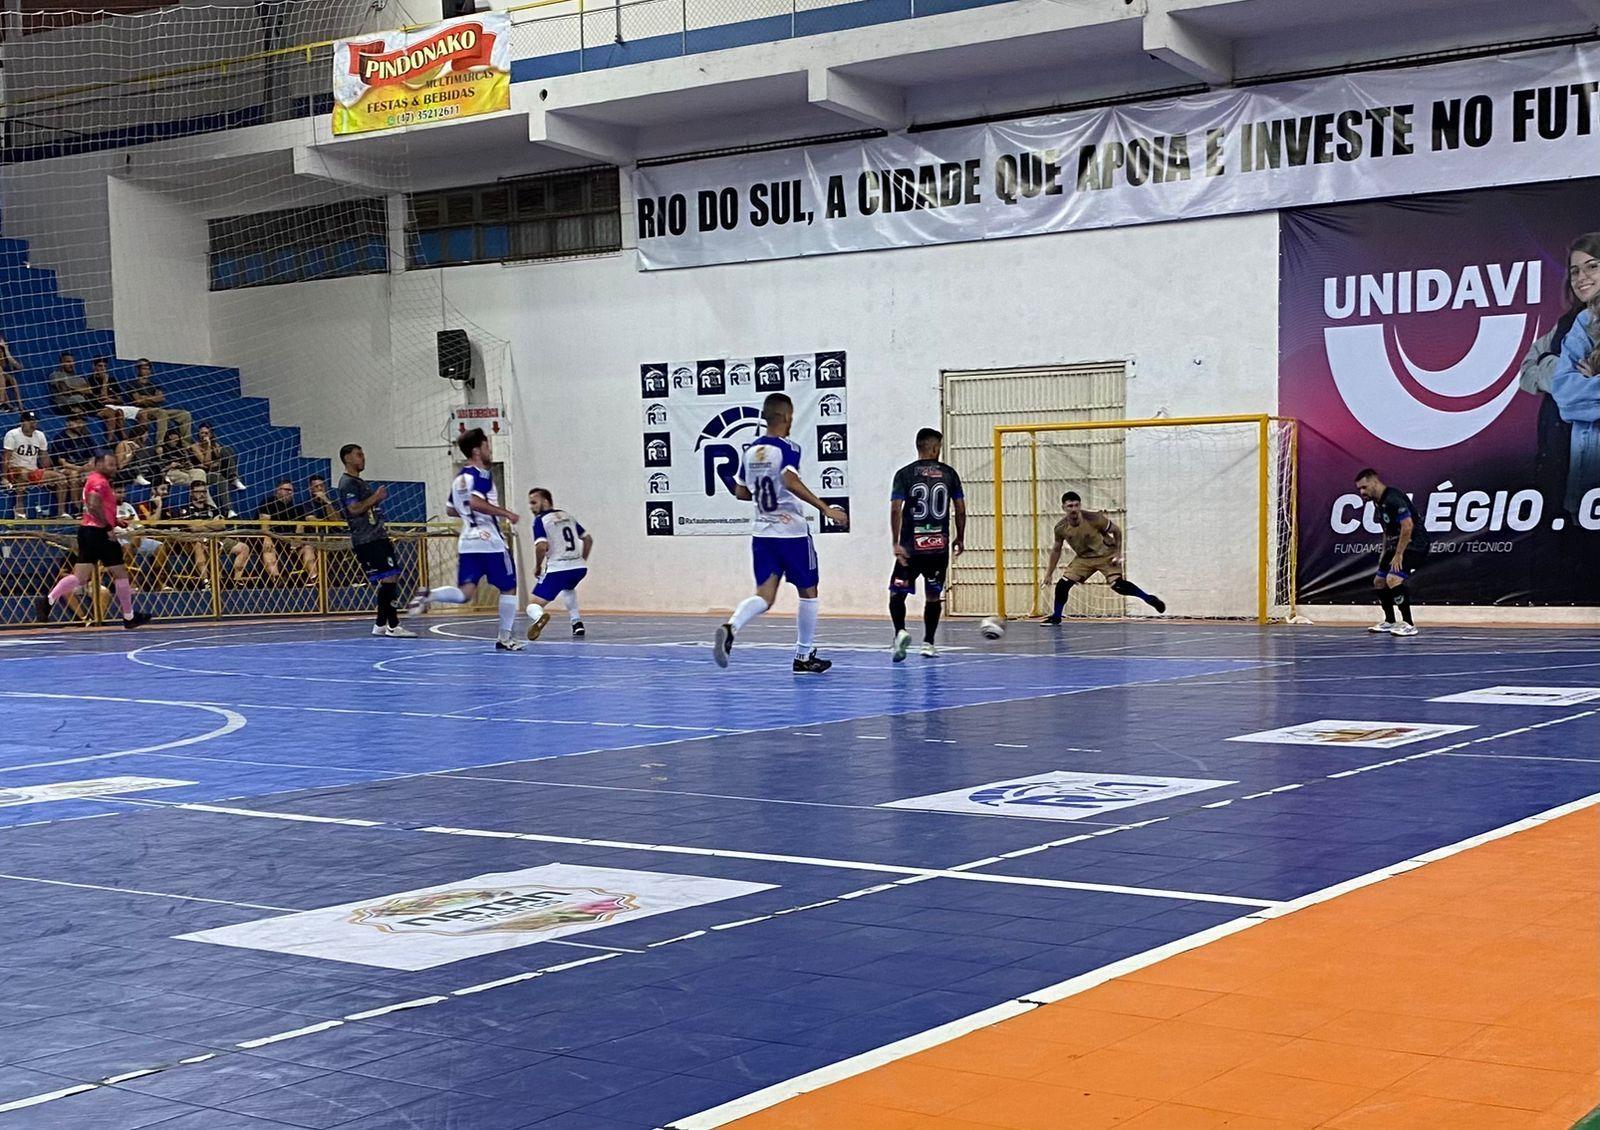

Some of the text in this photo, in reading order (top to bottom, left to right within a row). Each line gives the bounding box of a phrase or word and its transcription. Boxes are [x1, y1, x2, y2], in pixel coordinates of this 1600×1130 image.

[366, 29, 476, 81] PINDONAKO
[425, 70, 494, 89] MULTIMARCAS
[367, 87, 476, 113] FESTAS & BEBIDAS
[637, 193, 687, 239] RIO
[697, 186, 739, 232] DO
[749, 179, 814, 227] SUL,
[825, 175, 847, 219] A
[857, 159, 981, 216] CIDADE
[995, 149, 1063, 205] QUE
[1077, 132, 1192, 192] APOIA
[1206, 128, 1226, 178] E
[1240, 104, 1415, 174] INVESTE
[1431, 94, 1494, 152] NO
[1323, 260, 1542, 320] UNIDAVI
[754, 475, 778, 514] 10
[909, 482, 948, 520] 30
[1330, 480, 1544, 534] CÉGIO
[562, 526, 576, 552] 9
[1334, 543, 1383, 554] FUNDAME
[1428, 541, 1456, 553] ÉDIO
[1465, 540, 1513, 553] TÉCNICO
[398, 890, 571, 926] NATAN
